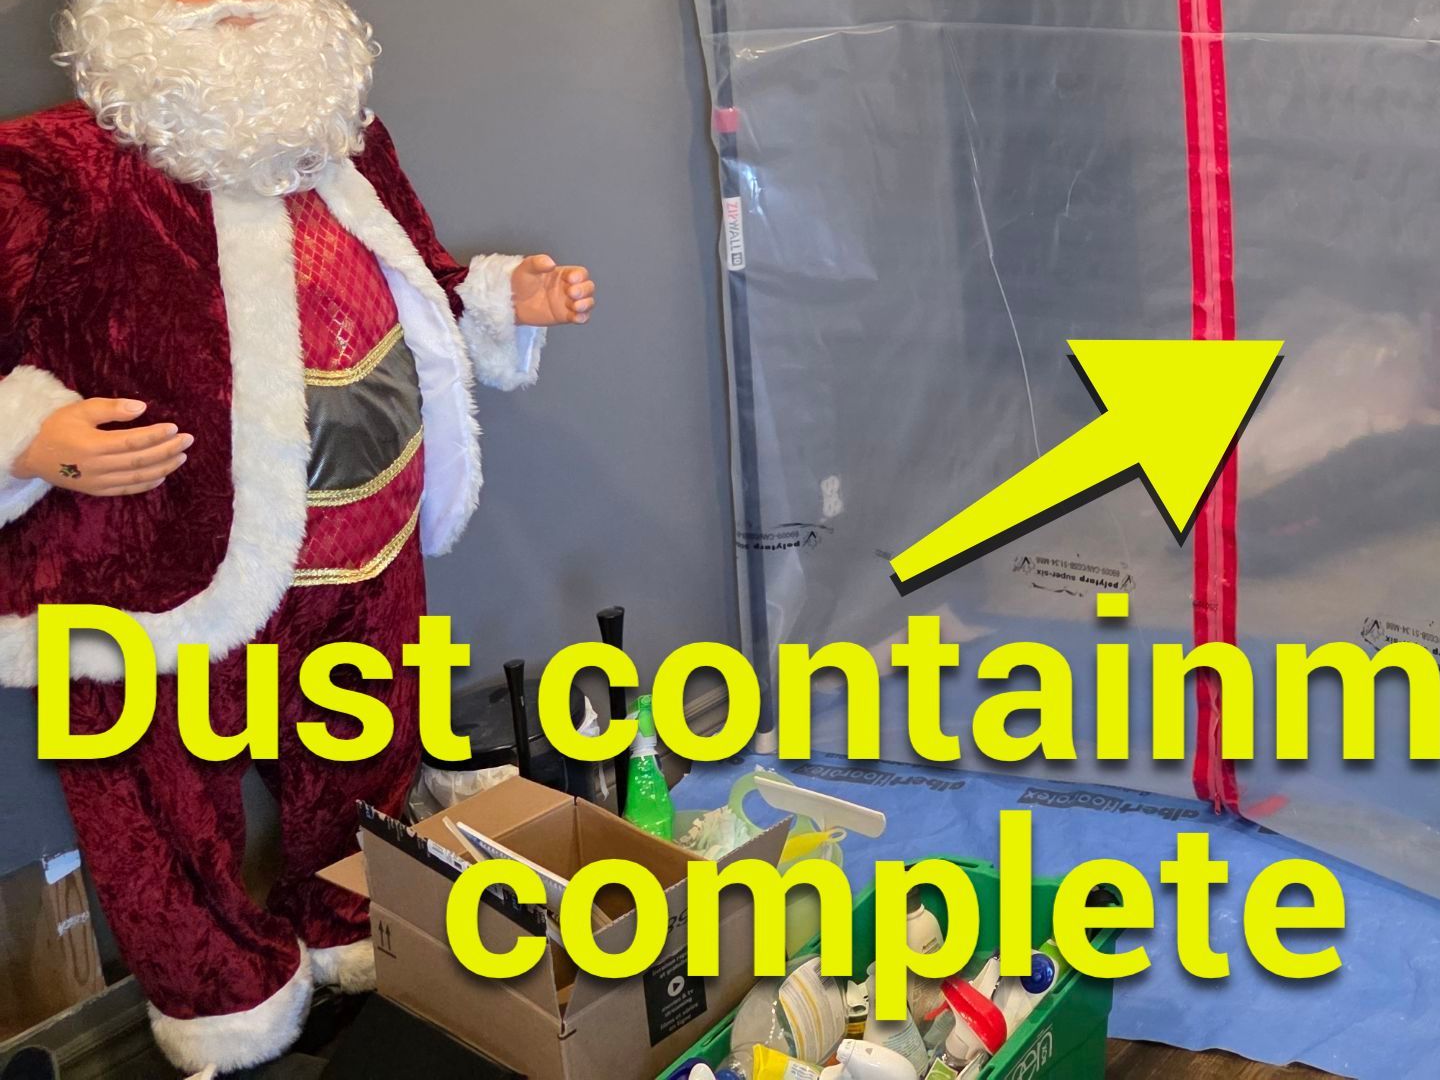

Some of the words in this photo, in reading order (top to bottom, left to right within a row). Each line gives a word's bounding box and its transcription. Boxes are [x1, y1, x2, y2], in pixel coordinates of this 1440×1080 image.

[753, 540, 801, 551] polytarp
[1035, 569, 1077, 583] super-six
[1078, 575, 1120, 590] polytarp
[1120, 801, 1201, 821] albert
